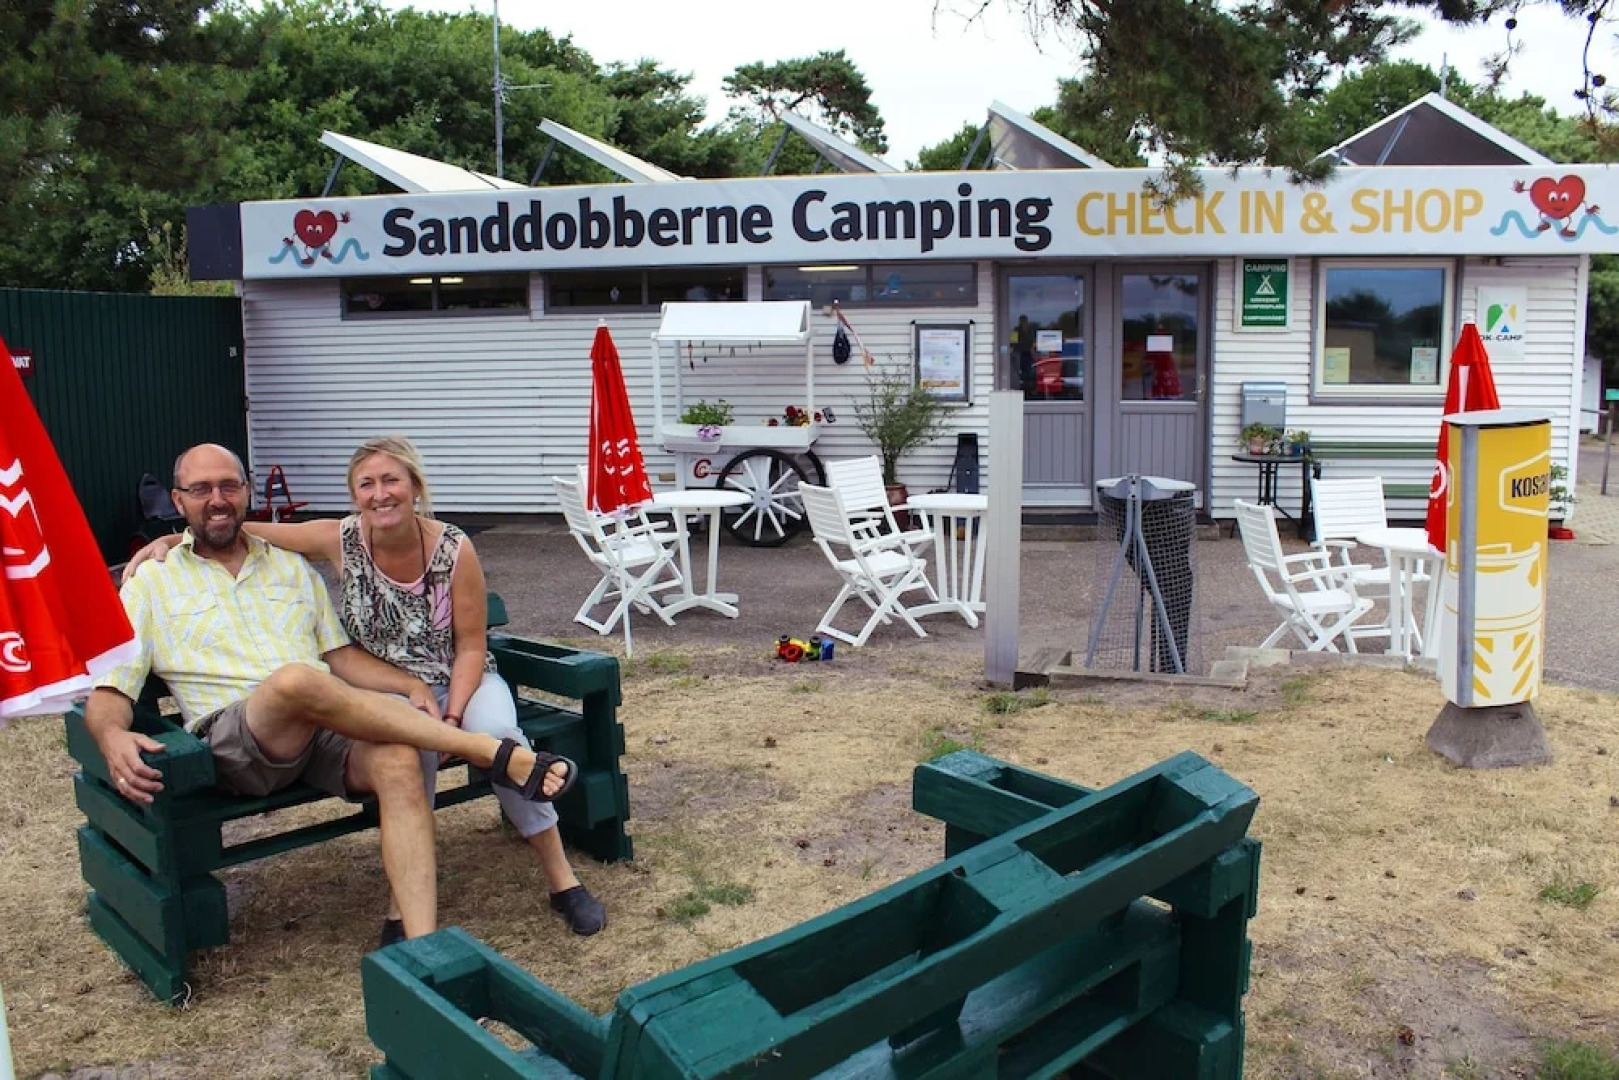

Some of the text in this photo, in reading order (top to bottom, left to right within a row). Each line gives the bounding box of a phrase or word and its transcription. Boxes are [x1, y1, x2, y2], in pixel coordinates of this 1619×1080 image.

[382, 182, 1484, 258] Sanddobberne Camping CHECK IN & SHOP
[1244, 263, 1287, 272] CAMPING
